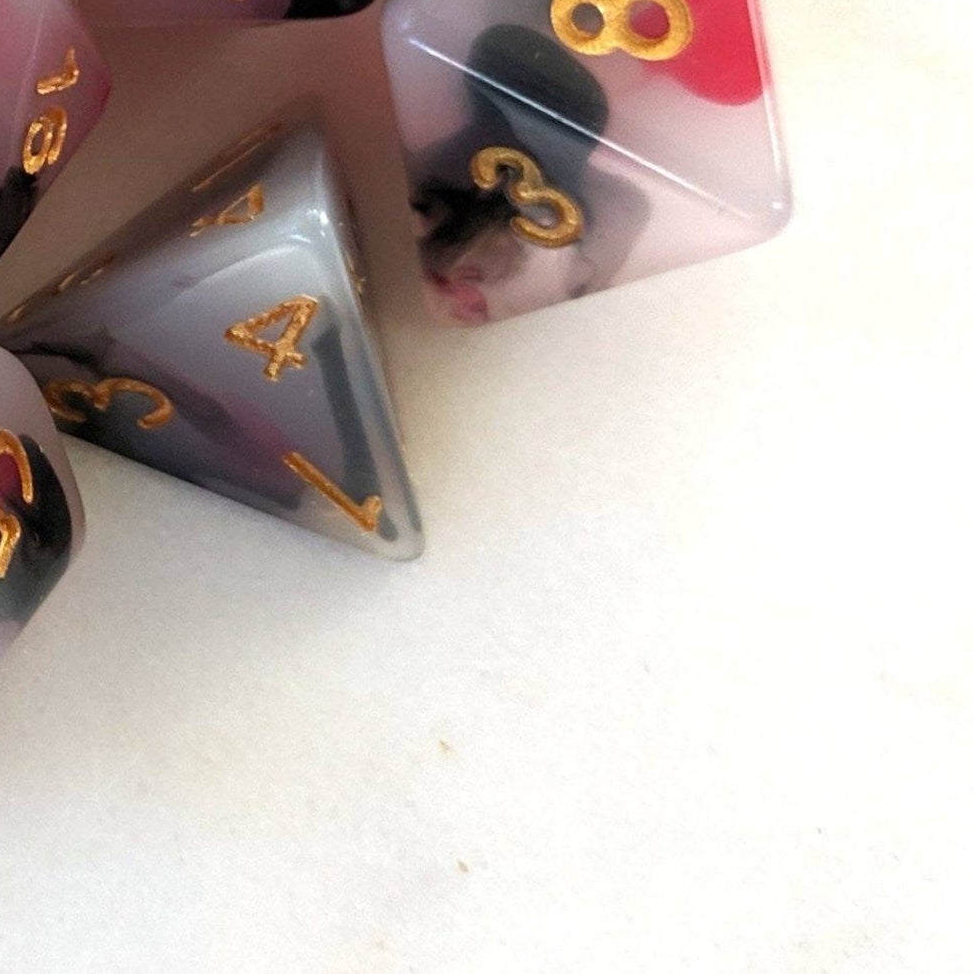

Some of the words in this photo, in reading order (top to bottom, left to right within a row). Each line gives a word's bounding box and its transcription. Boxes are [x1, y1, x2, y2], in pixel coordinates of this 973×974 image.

[469, 146, 584, 249] 3
[223, 293, 319, 382] 4
[44, 377, 175, 430] 3
[283, 450, 384, 531] 1
